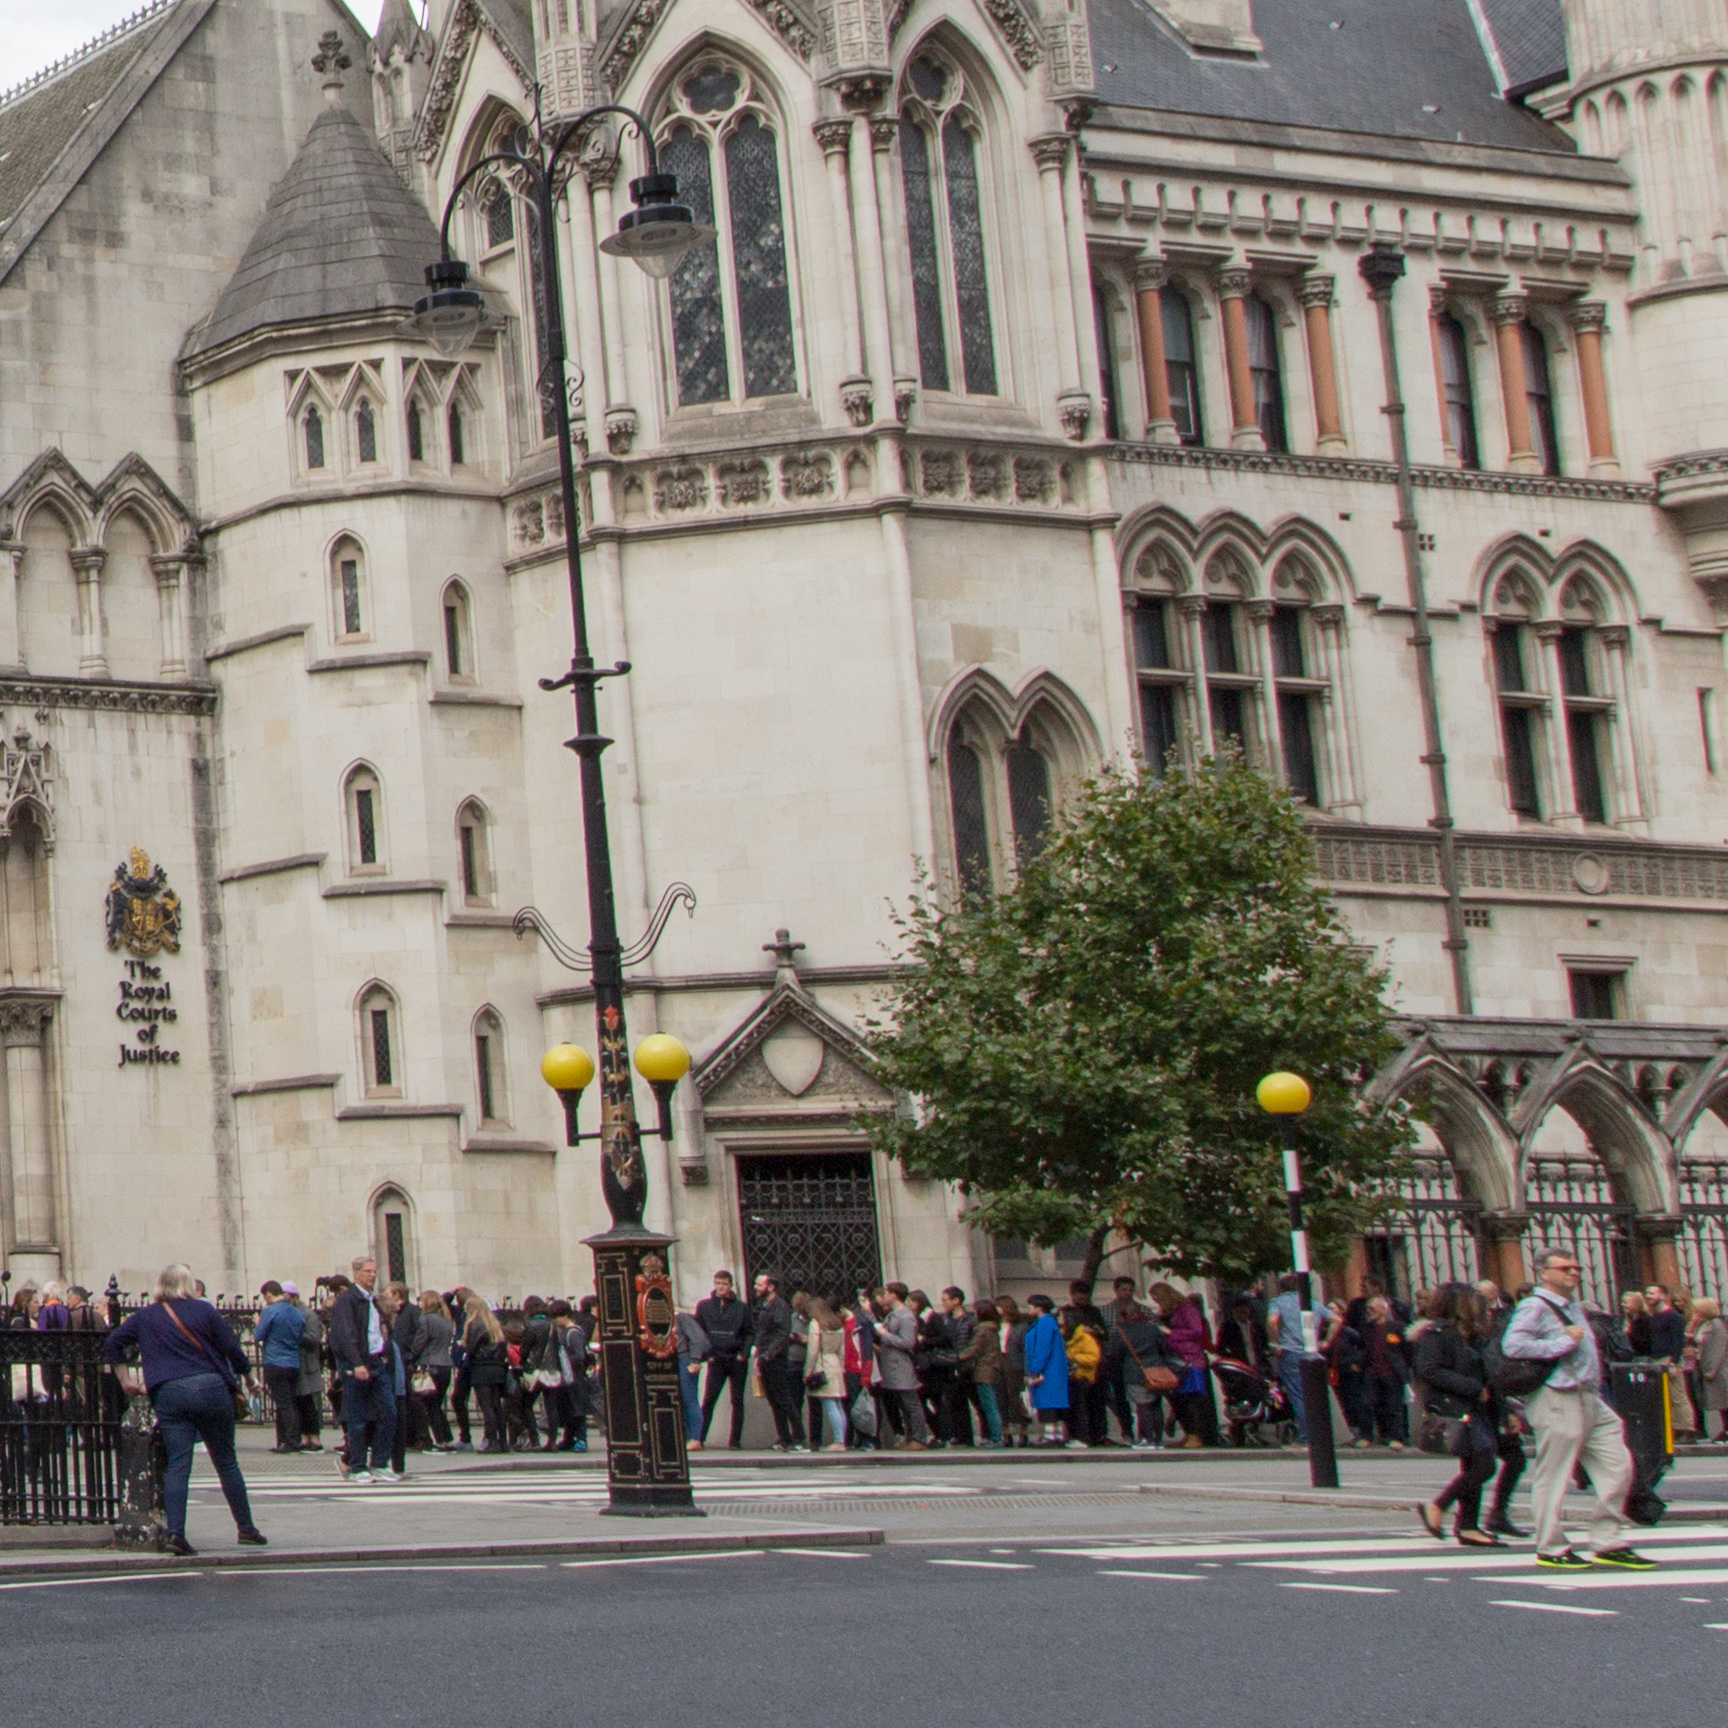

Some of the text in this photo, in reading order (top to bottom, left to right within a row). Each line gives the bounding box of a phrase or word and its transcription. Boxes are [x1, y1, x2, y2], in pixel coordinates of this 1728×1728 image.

[124, 959, 162, 979] The
[119, 980, 171, 1004] Royal
[116, 1002, 178, 1022] Courts
[137, 1023, 159, 1042] of
[118, 1044, 180, 1067] Justice
